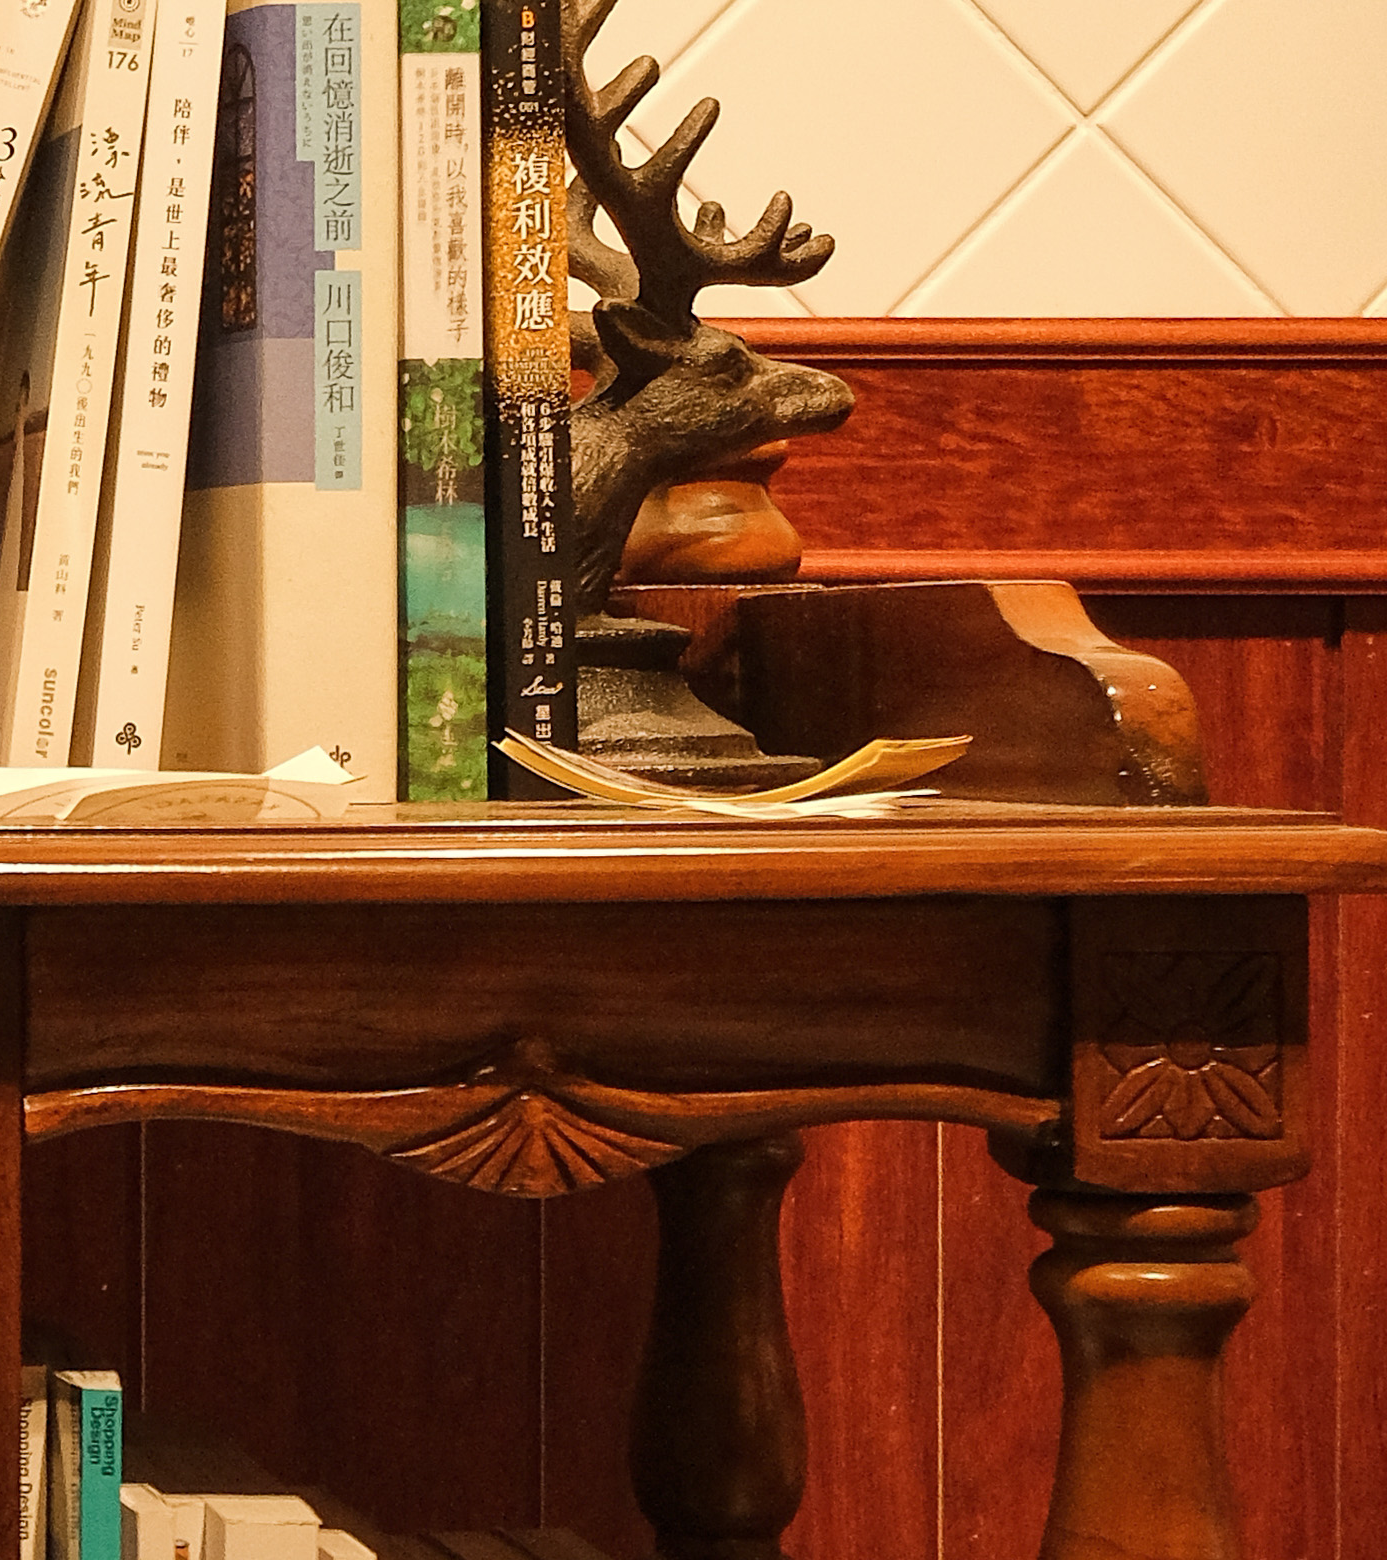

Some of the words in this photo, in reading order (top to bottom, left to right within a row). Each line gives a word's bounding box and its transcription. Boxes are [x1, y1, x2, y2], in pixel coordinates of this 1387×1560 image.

[105, 49, 141, 73] 176
[109, 28, 141, 43] Map
[111, 16, 142, 32] Mind
[321, 11, 356, 244] 在回憶消逝之前
[442, 66, 472, 344] 離開時，以我喜歡的樣子
[509, 150, 555, 333] 複利效應
[146, 96, 195, 411] 陪伴，是世上最奢侈的禮物
[321, 282, 356, 414] 川口俊和
[432, 403, 459, 507] 樹木希林
[132, 603, 147, 637] Peter
[88, 1406, 105, 1466] Design
[103, 1395, 117, 1477] Shopping
